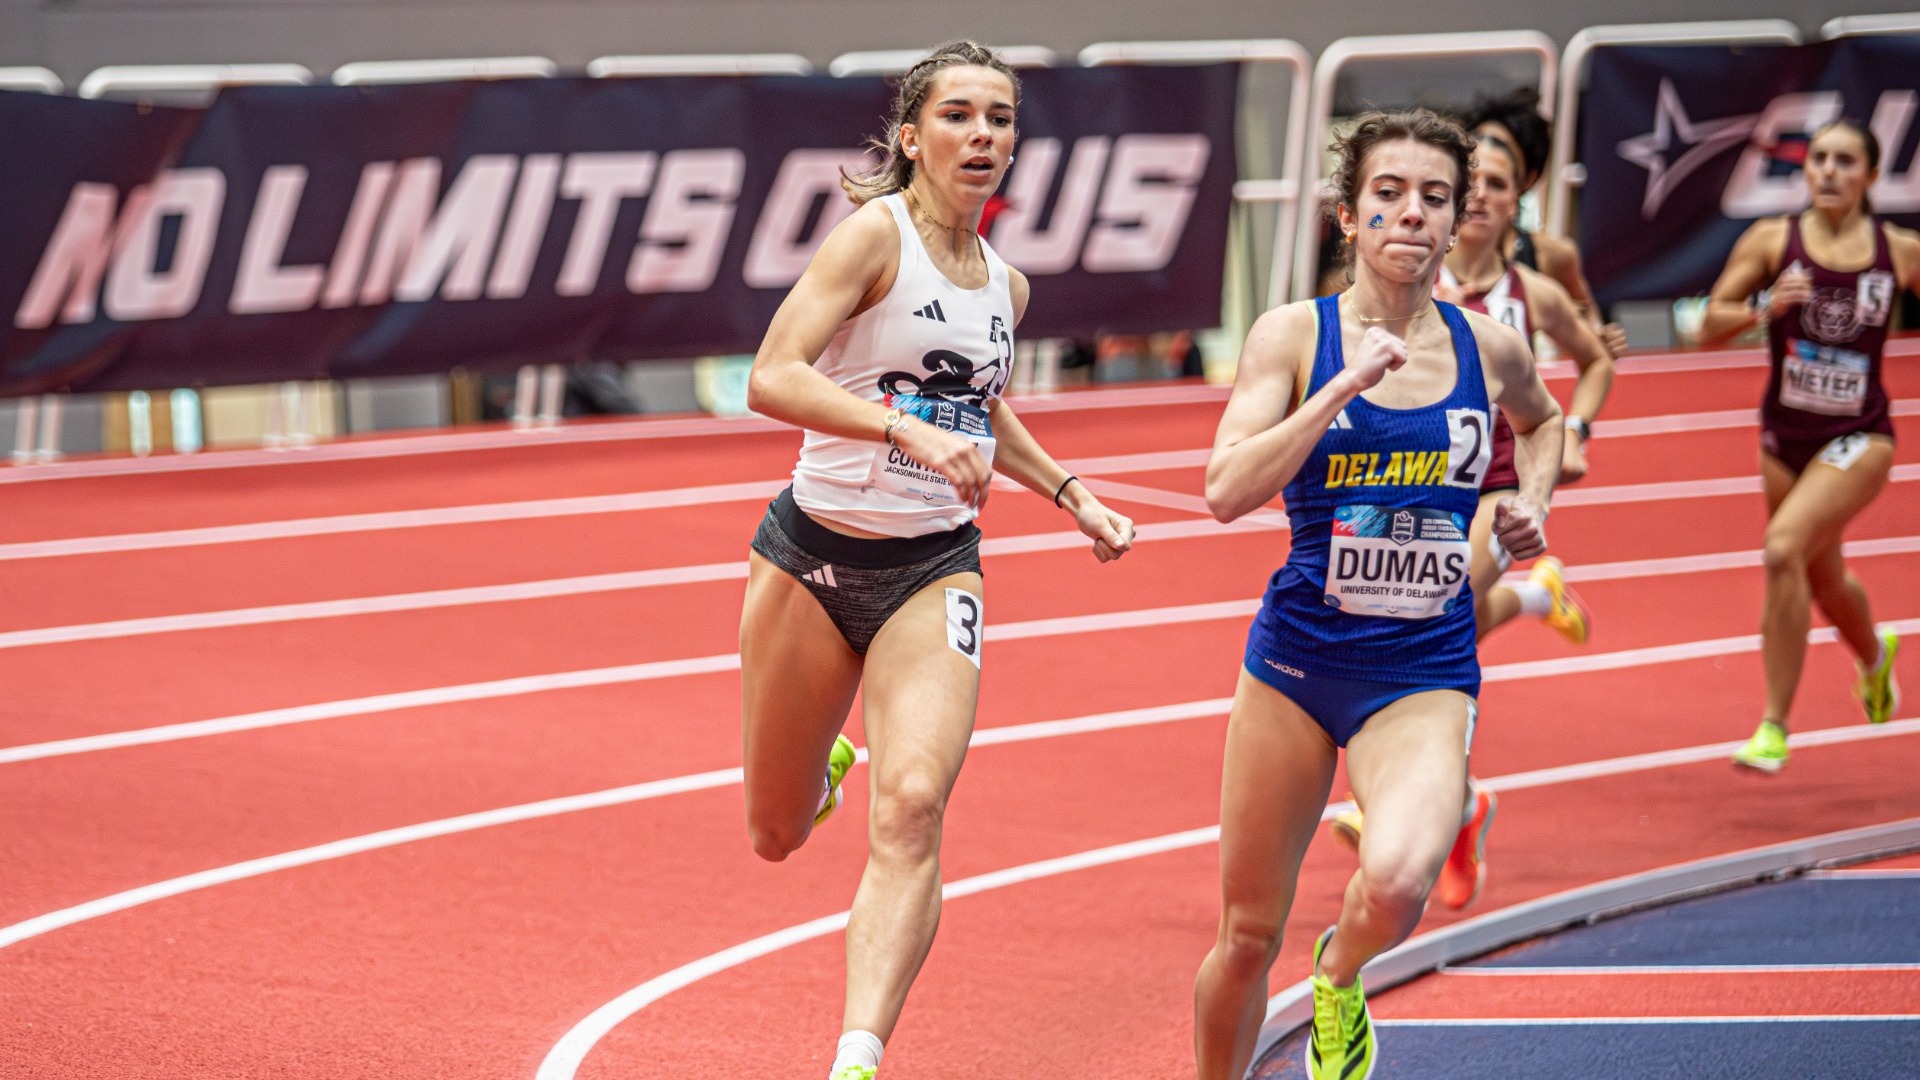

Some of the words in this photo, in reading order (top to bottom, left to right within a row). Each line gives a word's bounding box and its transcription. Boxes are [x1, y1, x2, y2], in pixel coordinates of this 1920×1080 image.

[14, 166, 227, 329] NO
[228, 147, 748, 315] LIMITS
[990, 133, 1212, 276] US
[1453, 415, 1482, 484] 2
[884, 465, 930, 482] JACKSONVILLE
[929, 475, 948, 486] STATE
[1336, 547, 1464, 586] DUMAS
[1340, 585, 1391, 596] UNIVERSITY
[1392, 588, 1404, 597] OF
[1406, 588, 1449, 599] DELAWARE
[957, 595, 977, 655] 3
